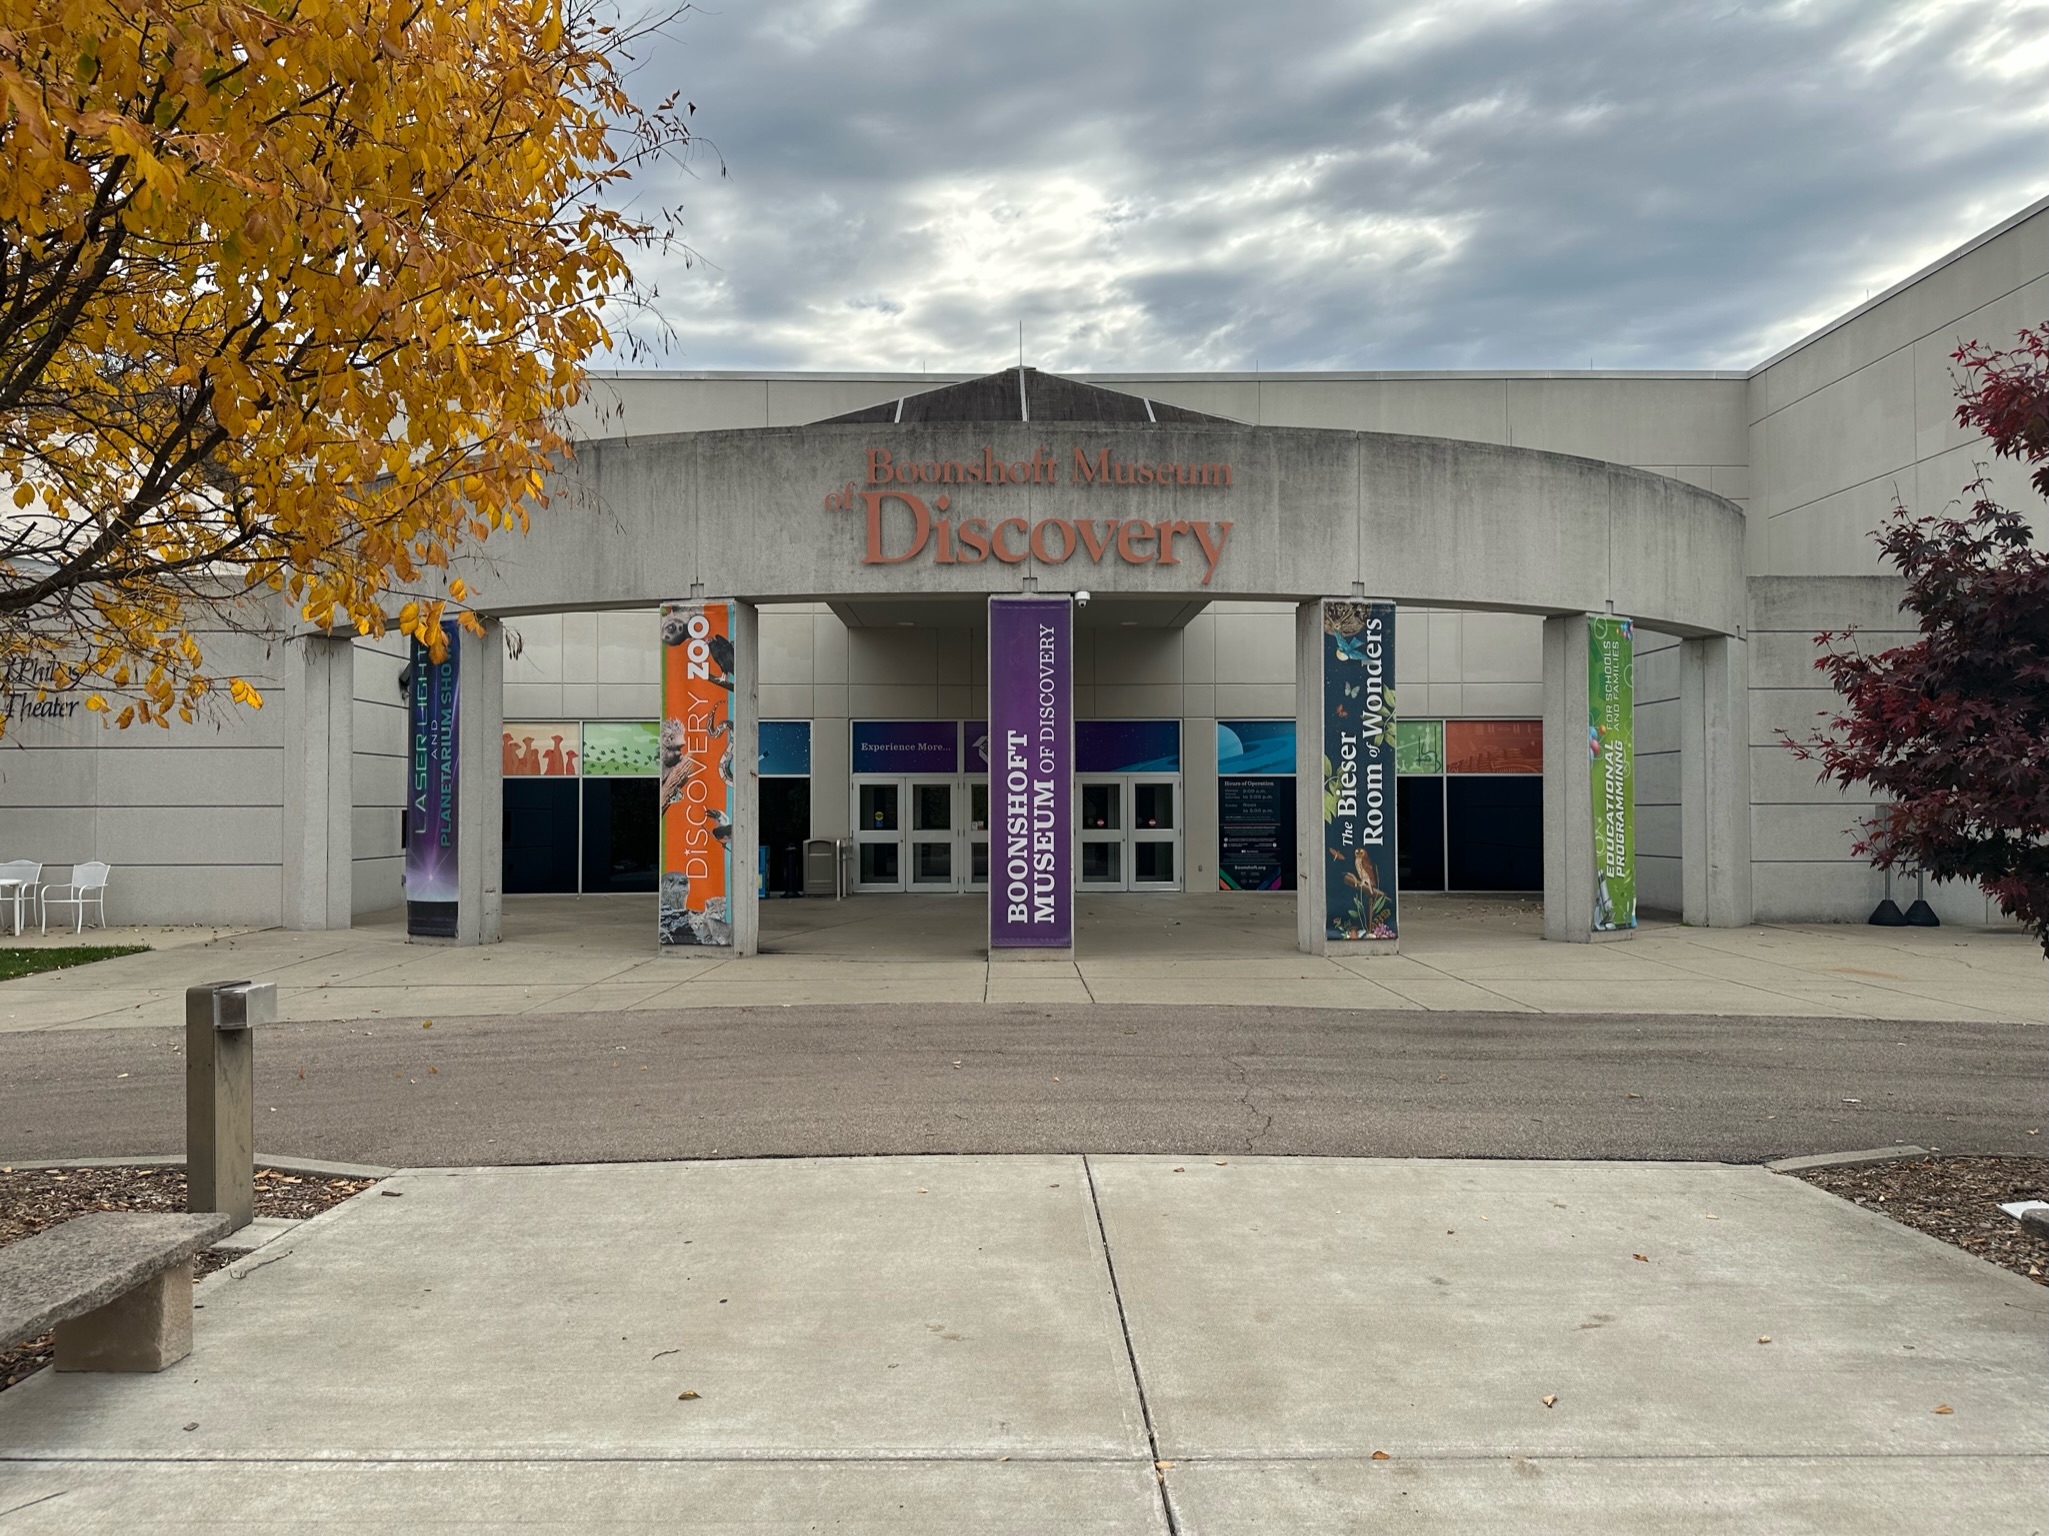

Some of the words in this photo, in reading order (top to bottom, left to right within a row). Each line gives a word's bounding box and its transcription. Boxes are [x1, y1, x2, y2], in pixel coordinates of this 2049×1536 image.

[866, 446, 1057, 486] Boonshoft
[1074, 447, 1233, 486] Museum
[824, 482, 857, 511] of
[860, 490, 1233, 585] Discovery
[687, 615, 710, 679] ZOO
[1040, 624, 1055, 741] DISCOVERY
[1362, 619, 1384, 738] Wonders
[1603, 641, 1612, 701] SCHOOLS
[1612, 641, 1620, 700] FAMILIES
[8, 692, 79, 722] Theater
[417, 646, 428, 725] LIGHT
[1605, 703, 1613, 730] FOR
[1612, 702, 1620, 731] AND
[440, 708, 452, 846] PLANETARIUM
[861, 742, 916, 752] Experience
[918, 742, 951, 751] More...
[1040, 746, 1055, 773] OF
[1336, 732, 1357, 816] Bieser
[1366, 742, 1379, 758] of
[415, 734, 428, 833] LASER
[1363, 764, 1384, 846] Room
[1605, 740, 1615, 878] EDUCATIONAL
[1007, 730, 1028, 923] BOONSHOFT
[1034, 779, 1055, 923] MUSEUM
[1342, 822, 1354, 846] The
